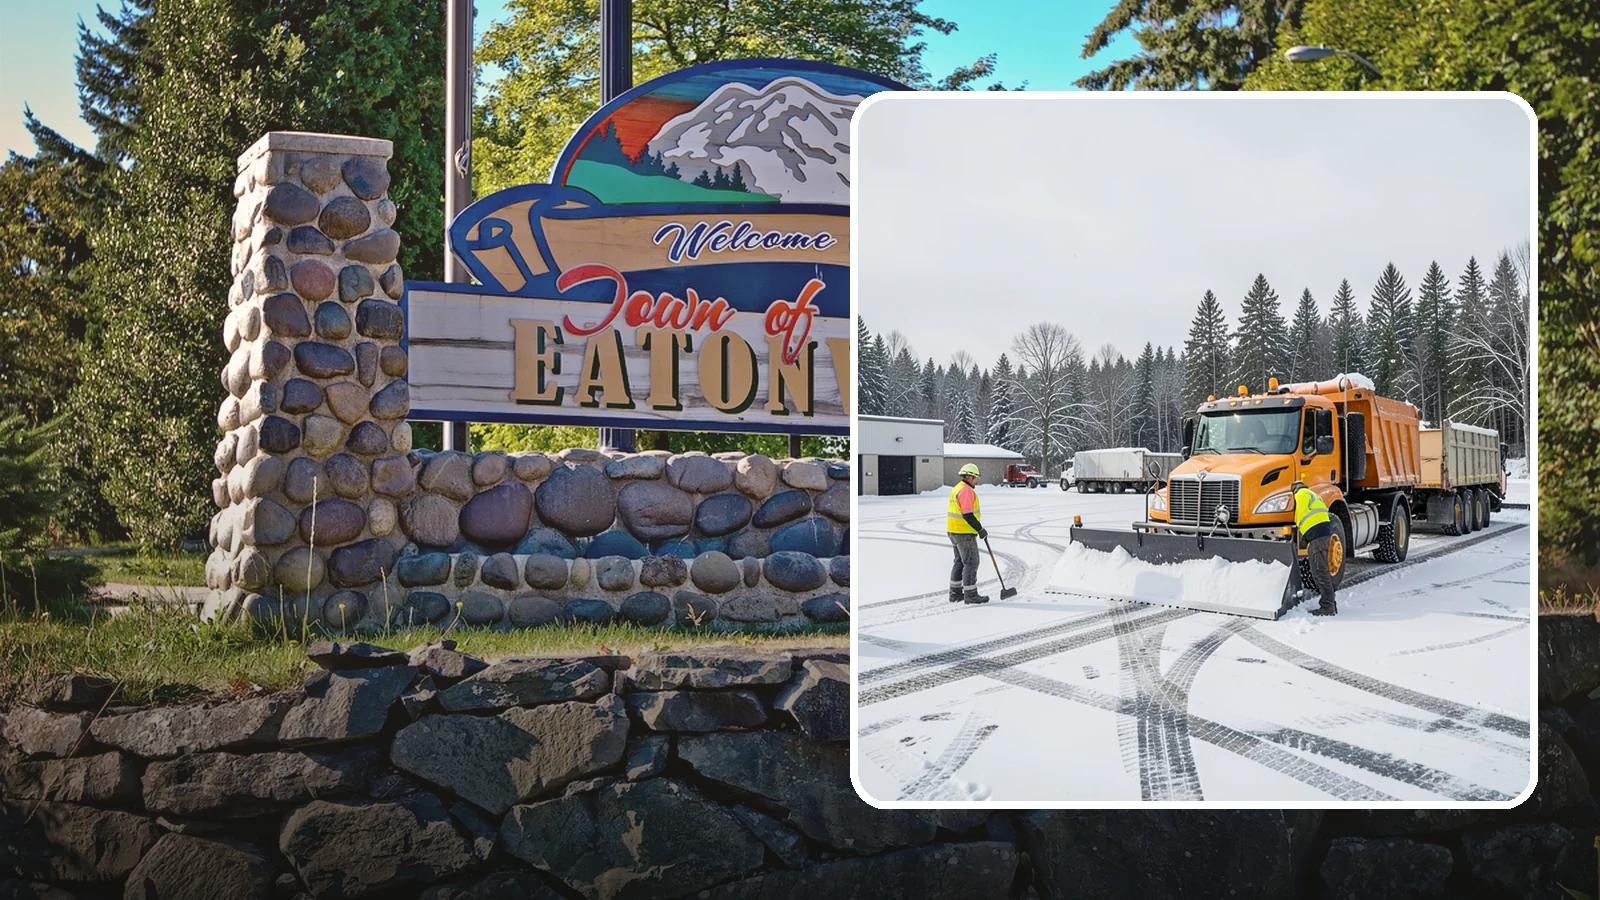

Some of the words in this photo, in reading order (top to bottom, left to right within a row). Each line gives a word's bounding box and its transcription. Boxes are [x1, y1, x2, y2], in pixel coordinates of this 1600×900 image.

[654, 221, 837, 263] Welcome
[557, 264, 736, 337] Town
[765, 278, 826, 365] of
